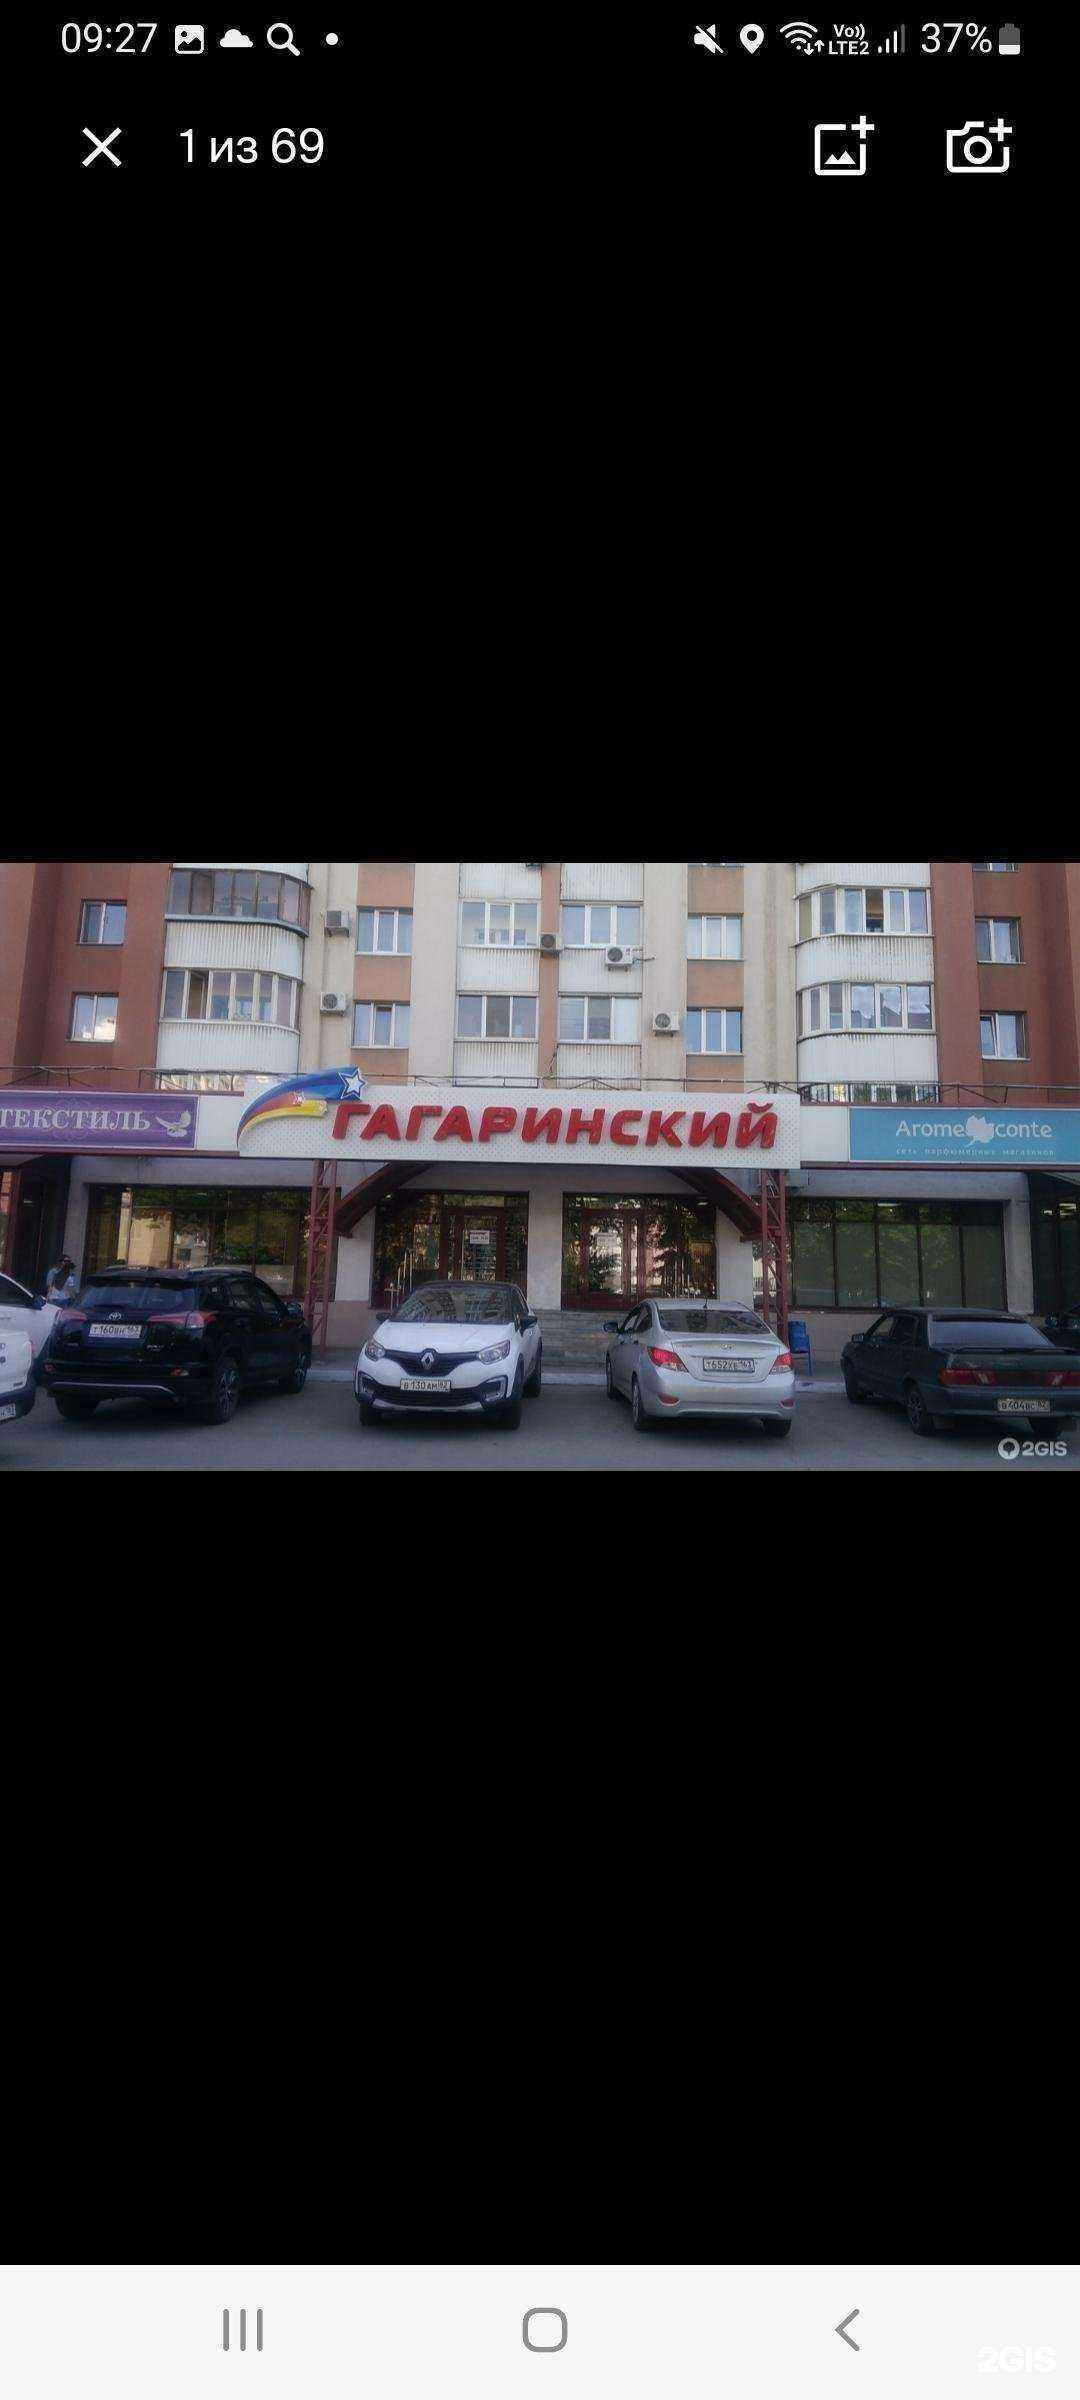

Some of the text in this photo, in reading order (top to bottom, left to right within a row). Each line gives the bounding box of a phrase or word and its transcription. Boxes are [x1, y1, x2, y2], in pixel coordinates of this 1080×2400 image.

[61, 22, 158, 53] 09:27
[828, 39, 870, 56] LTE2
[921, 22, 993, 55] 37%
[179, 127, 325, 164] 1 из 69
[0, 1109, 151, 1132] ТЕКСТИЛЬ
[332, 1102, 779, 1149] ГАГАРИНСКИЙ
[896, 1119, 963, 1138] Arome
